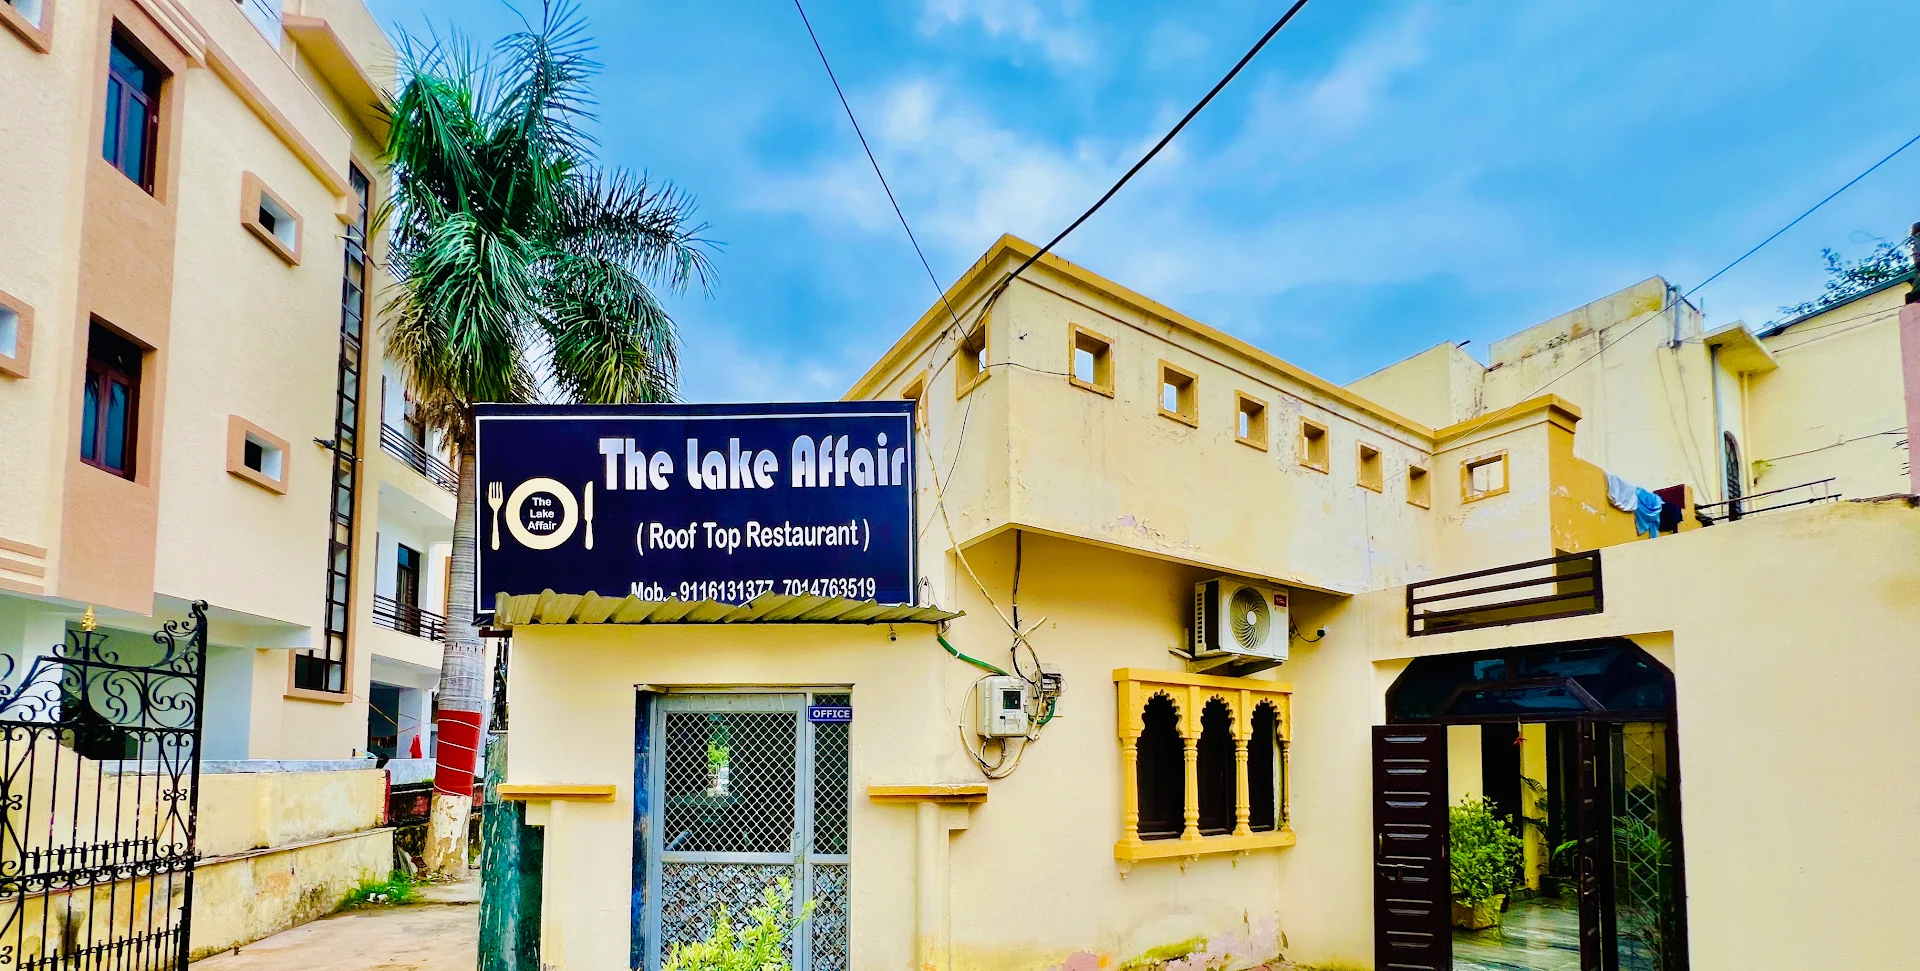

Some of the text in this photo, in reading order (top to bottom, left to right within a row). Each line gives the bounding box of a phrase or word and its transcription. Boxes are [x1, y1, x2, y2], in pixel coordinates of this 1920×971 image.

[599, 431, 905, 490] The Lake Affair
[531, 496, 552, 507] The
[529, 508, 555, 519] Lake
[527, 520, 558, 531] Affair
[702, 521, 741, 555] Top
[782, 576, 876, 599] 7014763519
[812, 709, 850, 718] OFFICE
